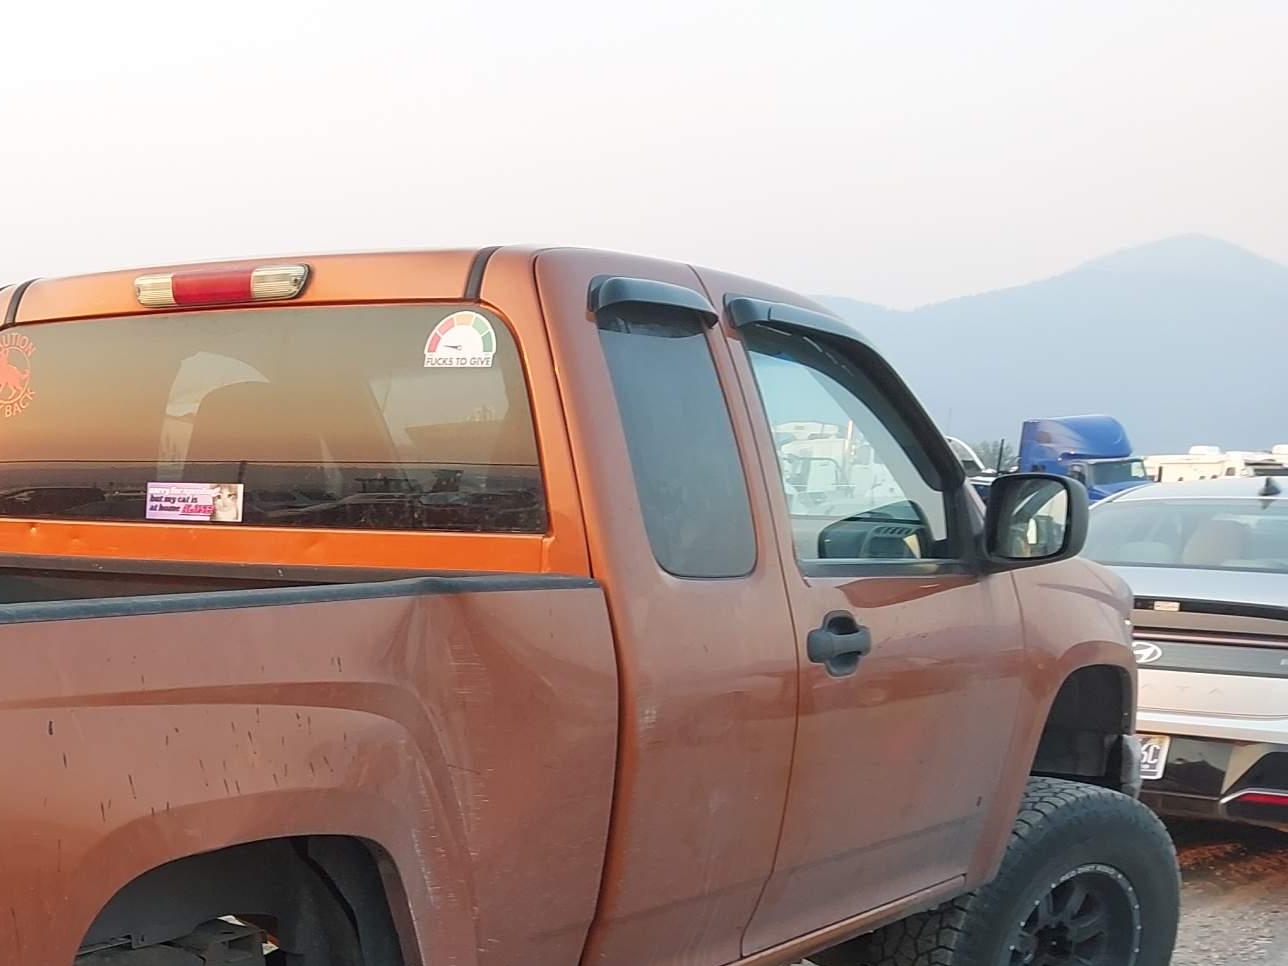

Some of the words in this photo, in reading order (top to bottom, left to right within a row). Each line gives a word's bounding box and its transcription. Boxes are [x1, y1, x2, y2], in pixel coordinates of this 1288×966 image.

[426, 357, 453, 366] FUCKS
[455, 357, 467, 366] TO
[470, 357, 491, 366] GIVE
[5, 388, 36, 417] BACK
[164, 496, 176, 504] my
[178, 495, 189, 503] cat
[191, 495, 198, 503] is
[159, 504, 181, 512] home
